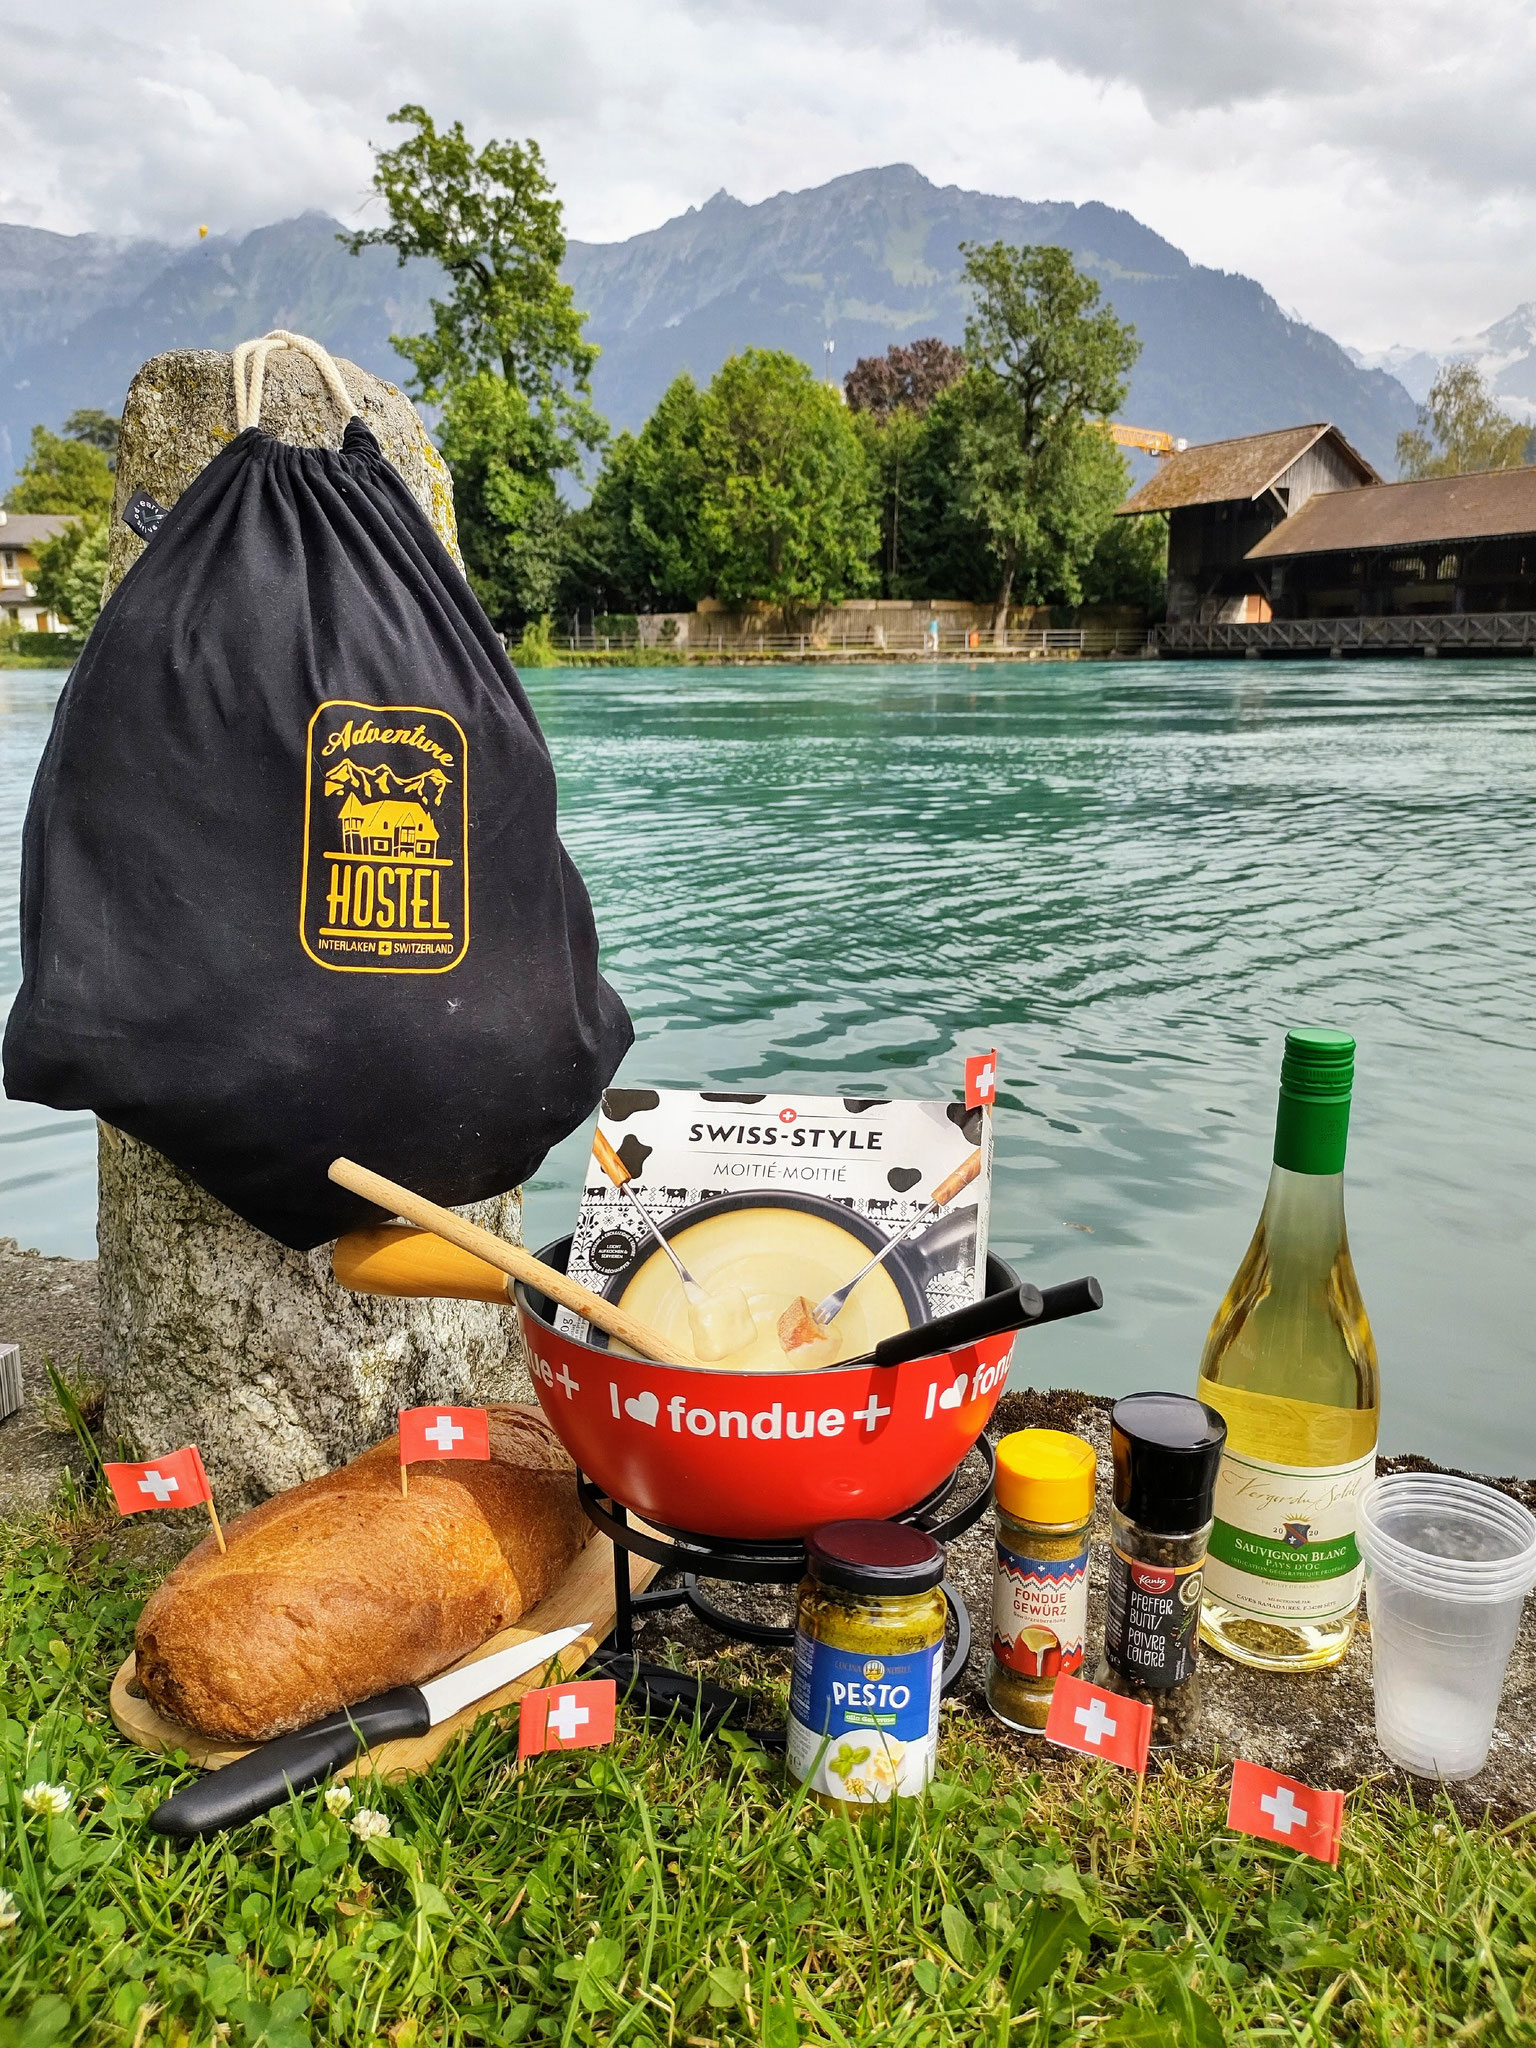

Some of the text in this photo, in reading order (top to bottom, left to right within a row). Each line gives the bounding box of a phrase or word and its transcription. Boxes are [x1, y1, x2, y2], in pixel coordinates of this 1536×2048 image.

[321, 719, 455, 767] Adventure
[326, 863, 450, 929] HOSTEL
[318, 938, 454, 955] INTERLAKEN SWITZERLAND
[688, 1123, 883, 1150] SWISS-STYLE
[713, 1161, 848, 1182] MOITIÉ-MOITIÉ
[667, 1395, 846, 1440] fondue
[1272, 1527, 1284, 1535] 20
[1234, 1538, 1347, 1562] SAUVIGNON BLANC
[1265, 1558, 1321, 1571] PAYS D'OC
[1015, 1587, 1067, 1604] FONDUE
[1236, 1593, 1257, 1604] CAVES
[1013, 1600, 1067, 1617] GEWÜRZ
[832, 1681, 911, 1709] PESTO
